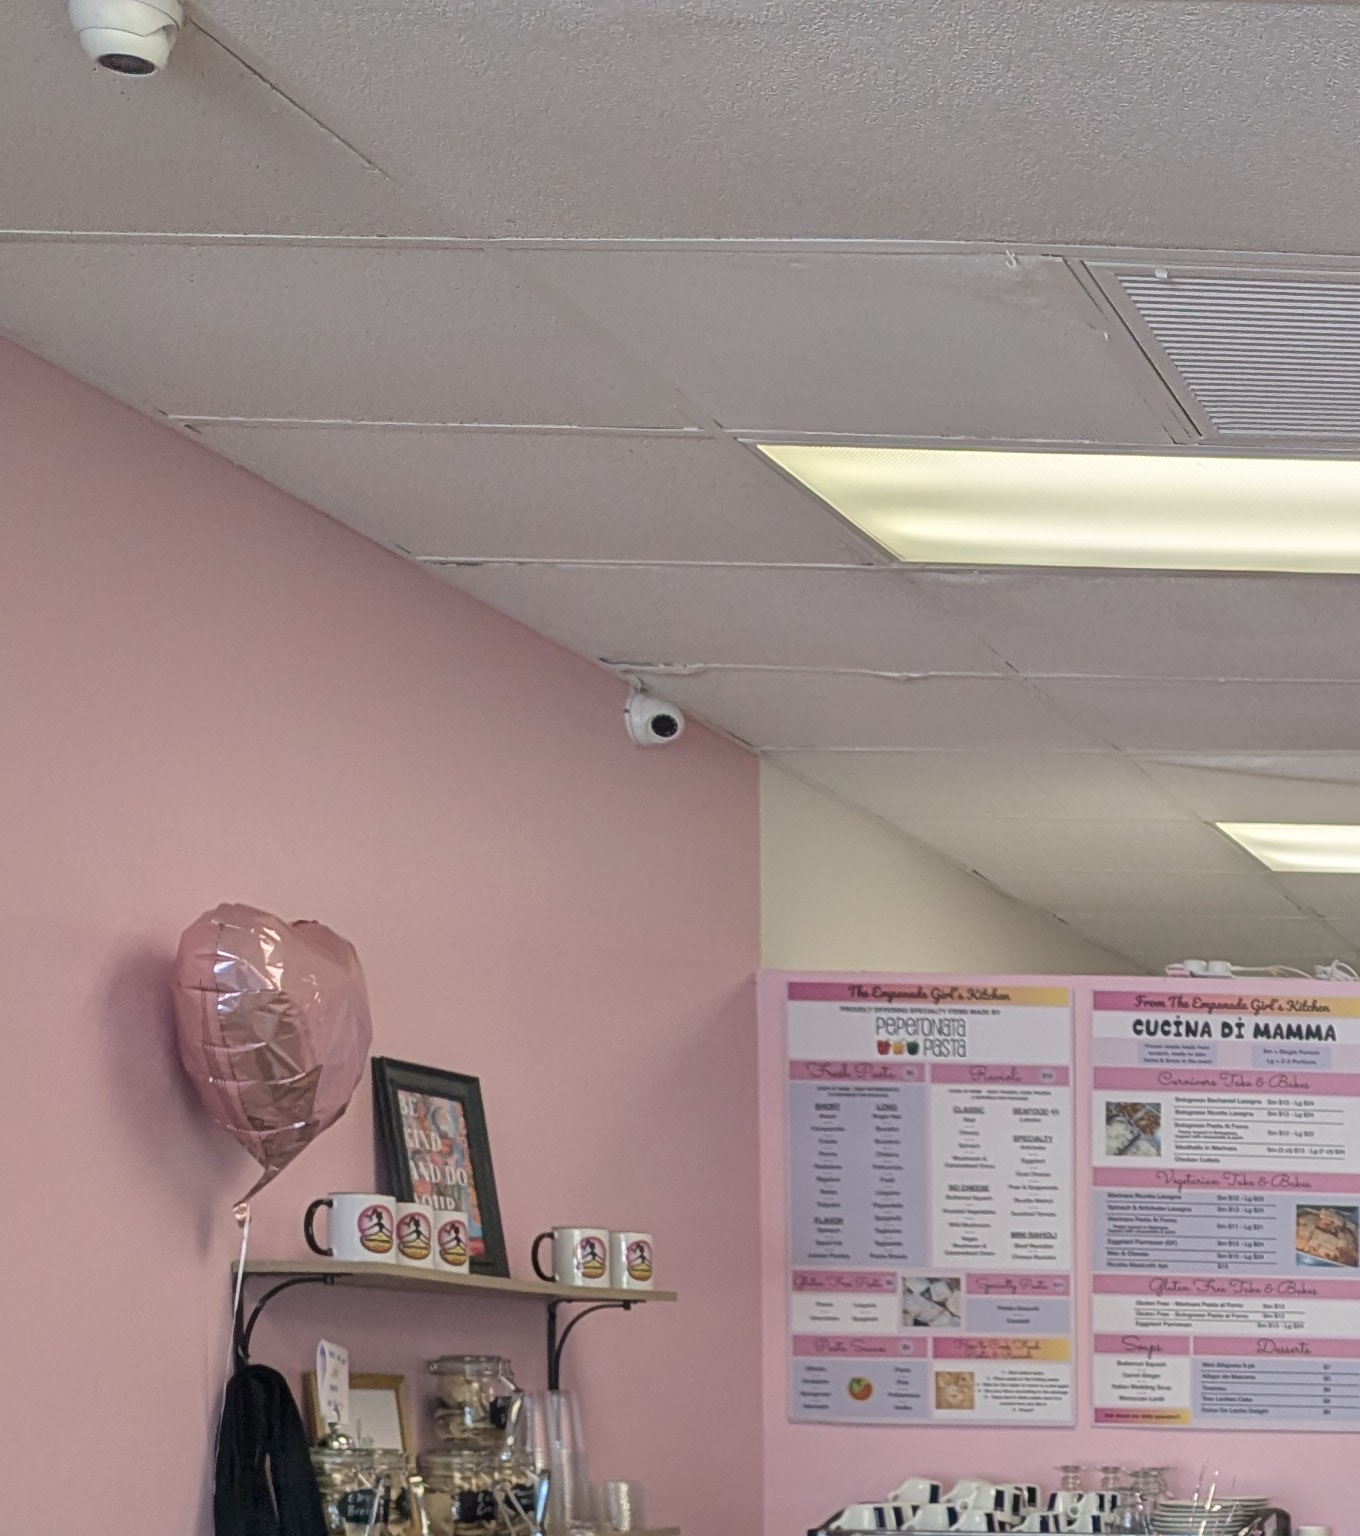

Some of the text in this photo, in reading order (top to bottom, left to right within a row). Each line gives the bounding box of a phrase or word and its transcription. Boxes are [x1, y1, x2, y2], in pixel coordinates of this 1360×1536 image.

[848, 985, 870, 999] The
[1134, 995, 1331, 1015] From The Empanada Girl's Kitchen
[1132, 1015, 1213, 1038] CUCINA
[1253, 1022, 1337, 1042] MAMMA
[1220, 1071, 1253, 1088] Take
[409, 1161, 468, 1186] AND DO
[1157, 1169, 1221, 1193] Vegetarian
[1121, 1335, 1163, 1360] Soups
[1257, 1337, 1311, 1356] Desserts
